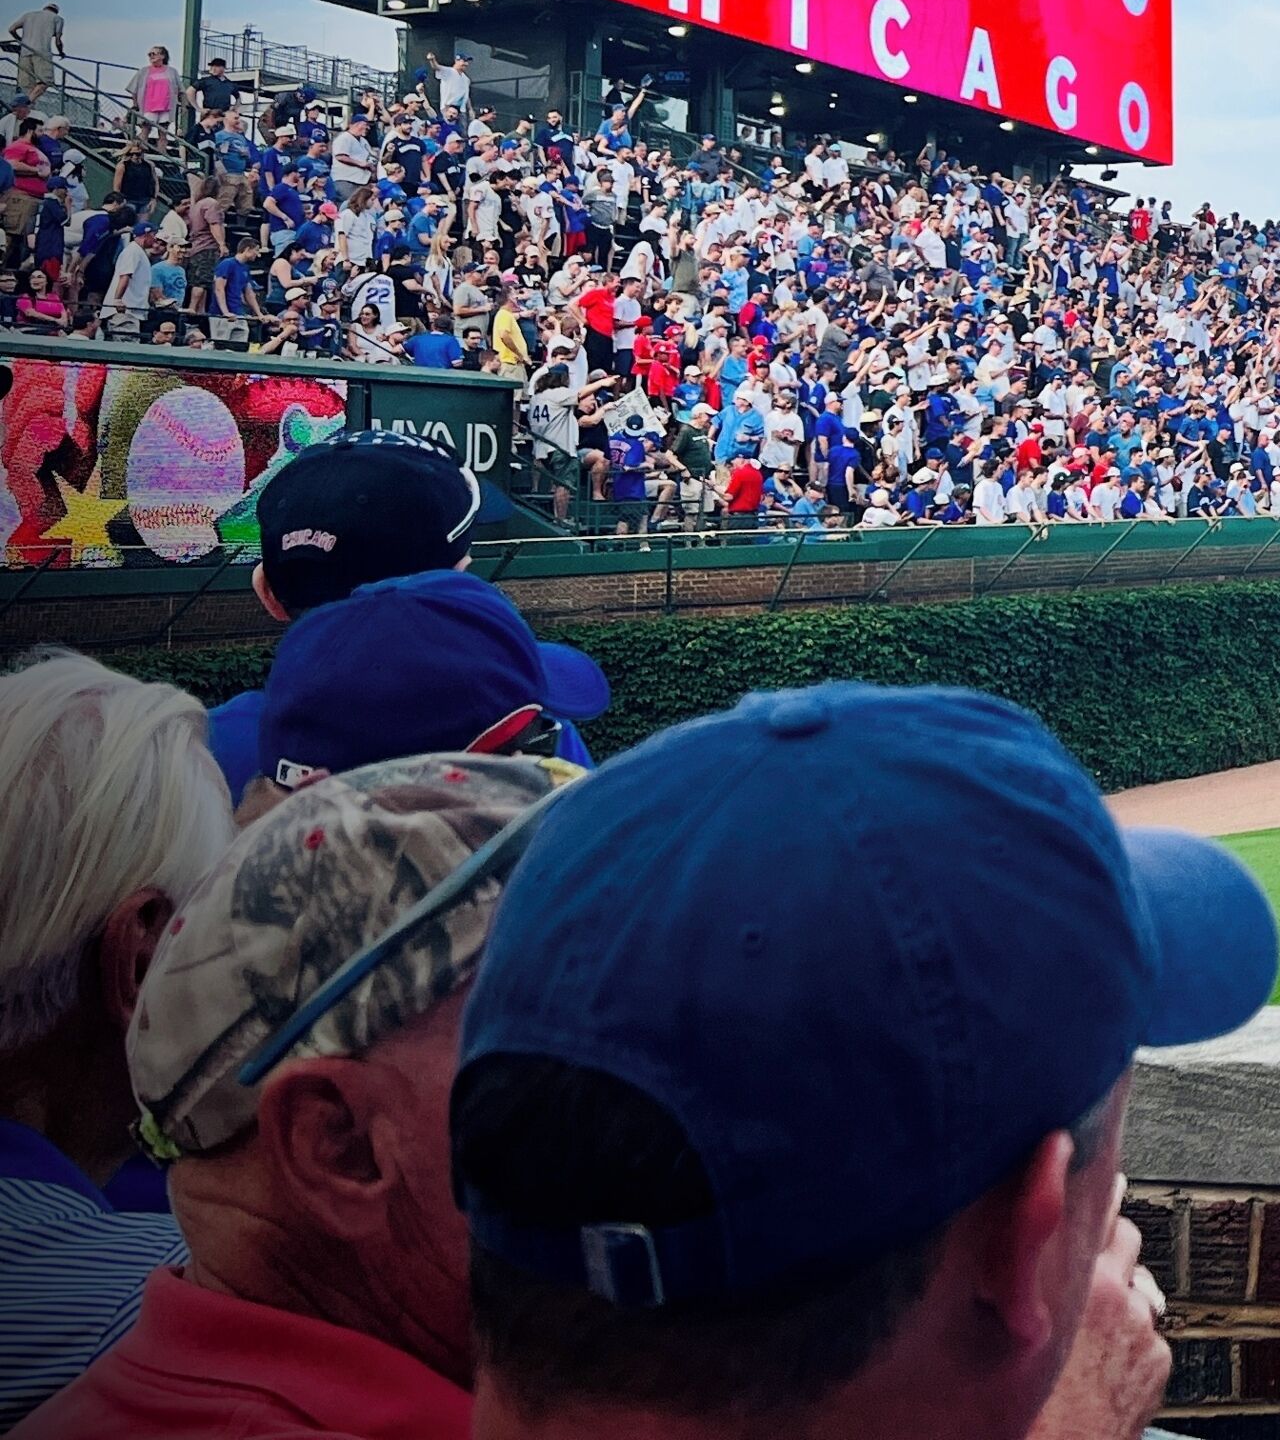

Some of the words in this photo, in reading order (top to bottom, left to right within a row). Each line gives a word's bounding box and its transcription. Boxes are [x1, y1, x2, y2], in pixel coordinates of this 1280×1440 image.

[366, 287, 390, 305] 22
[532, 405, 550, 423] 44
[281, 527, 336, 553] CHICAGO
